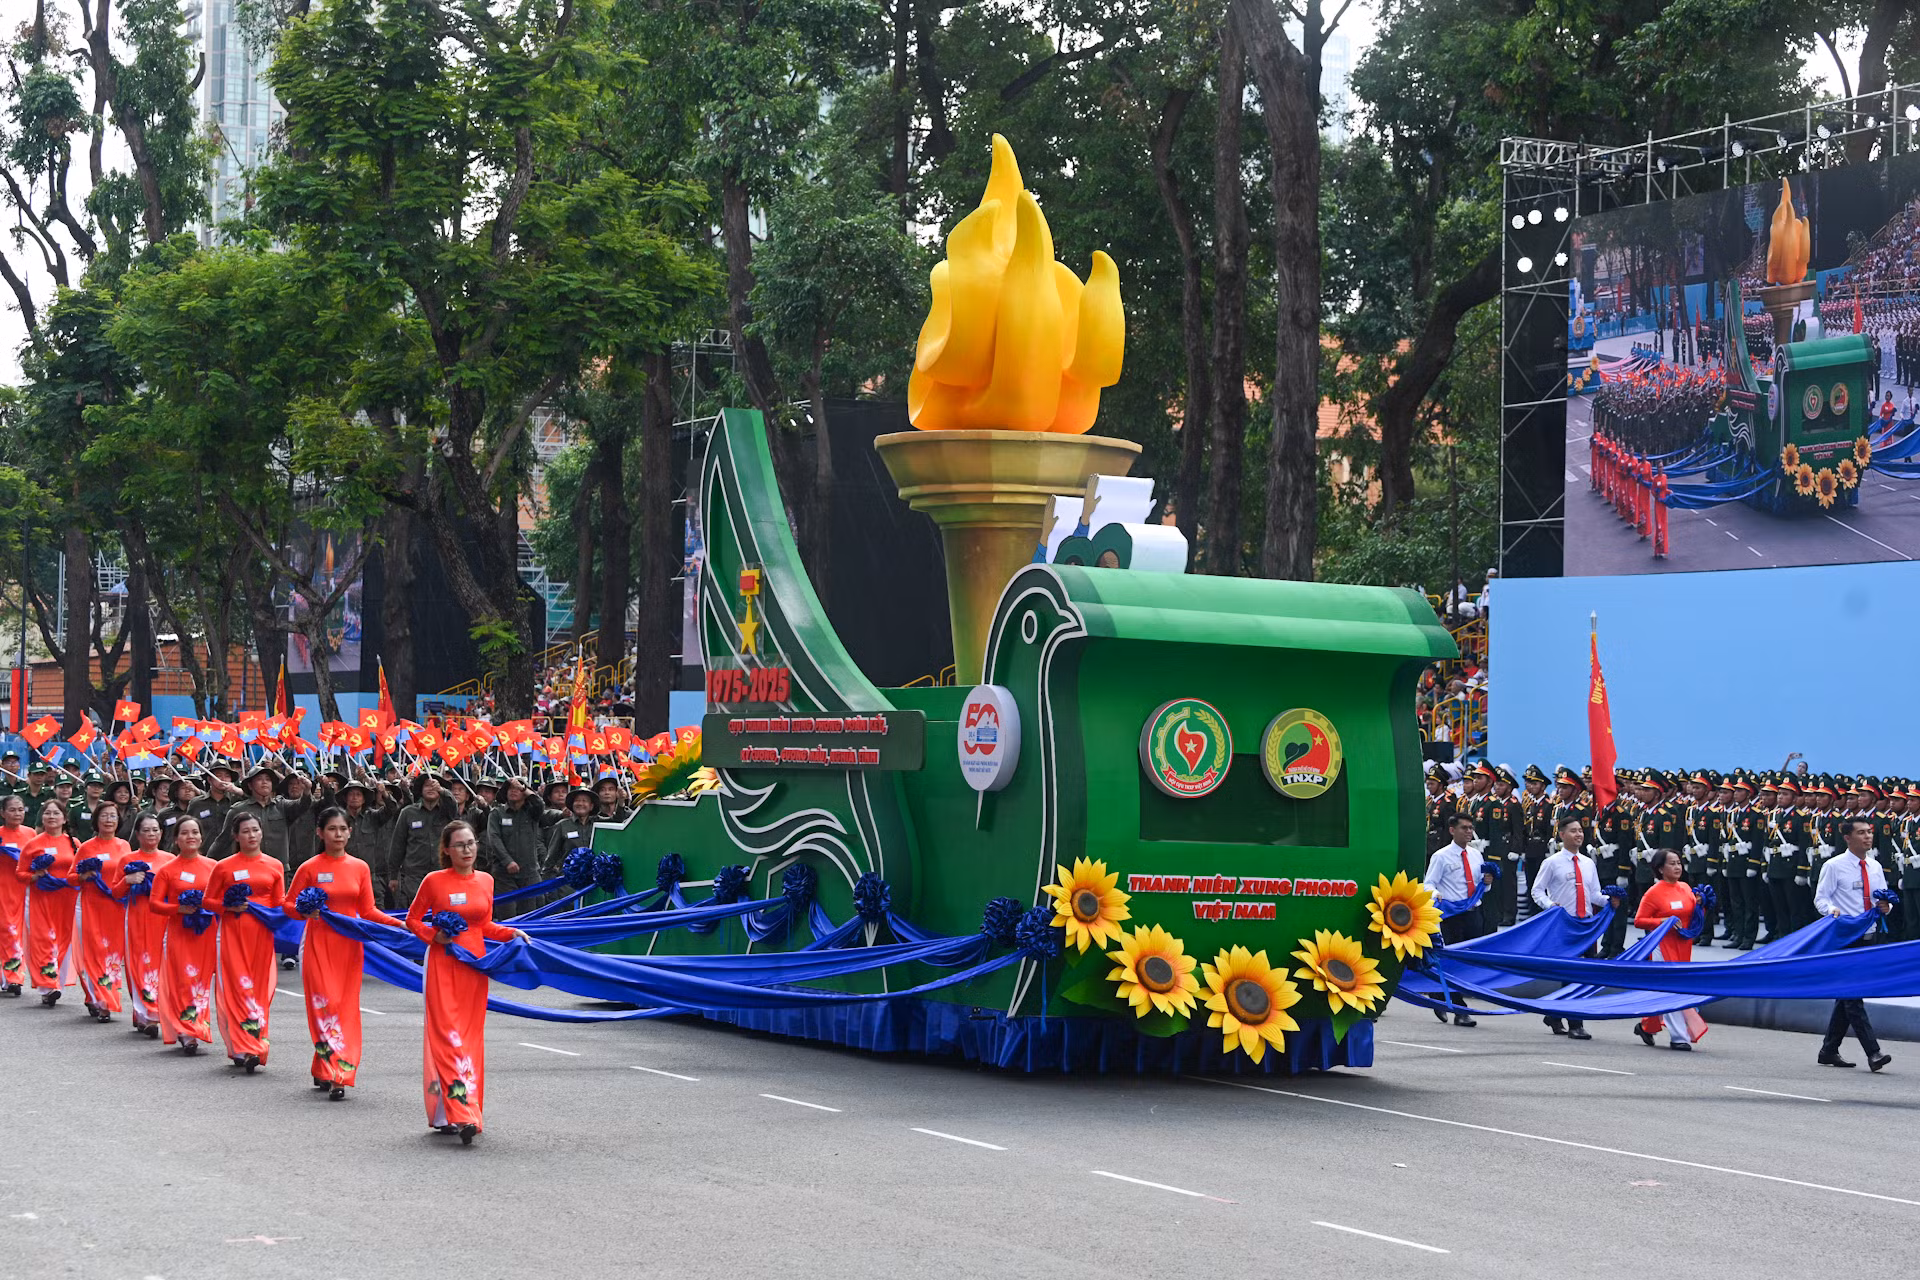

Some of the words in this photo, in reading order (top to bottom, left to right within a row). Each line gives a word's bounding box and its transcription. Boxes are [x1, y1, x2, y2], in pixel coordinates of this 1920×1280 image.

[706, 667, 790, 703] 1975-2025
[1283, 773, 1323, 785] TNXP
[1128, 874, 1191, 892] THANH
[1191, 873, 1237, 894] NIÊN
[1237, 877, 1292, 896] XUNG
[1293, 878, 1359, 897] PHONG
[1192, 899, 1233, 922] VIỆT
[1233, 902, 1276, 920] NAM
